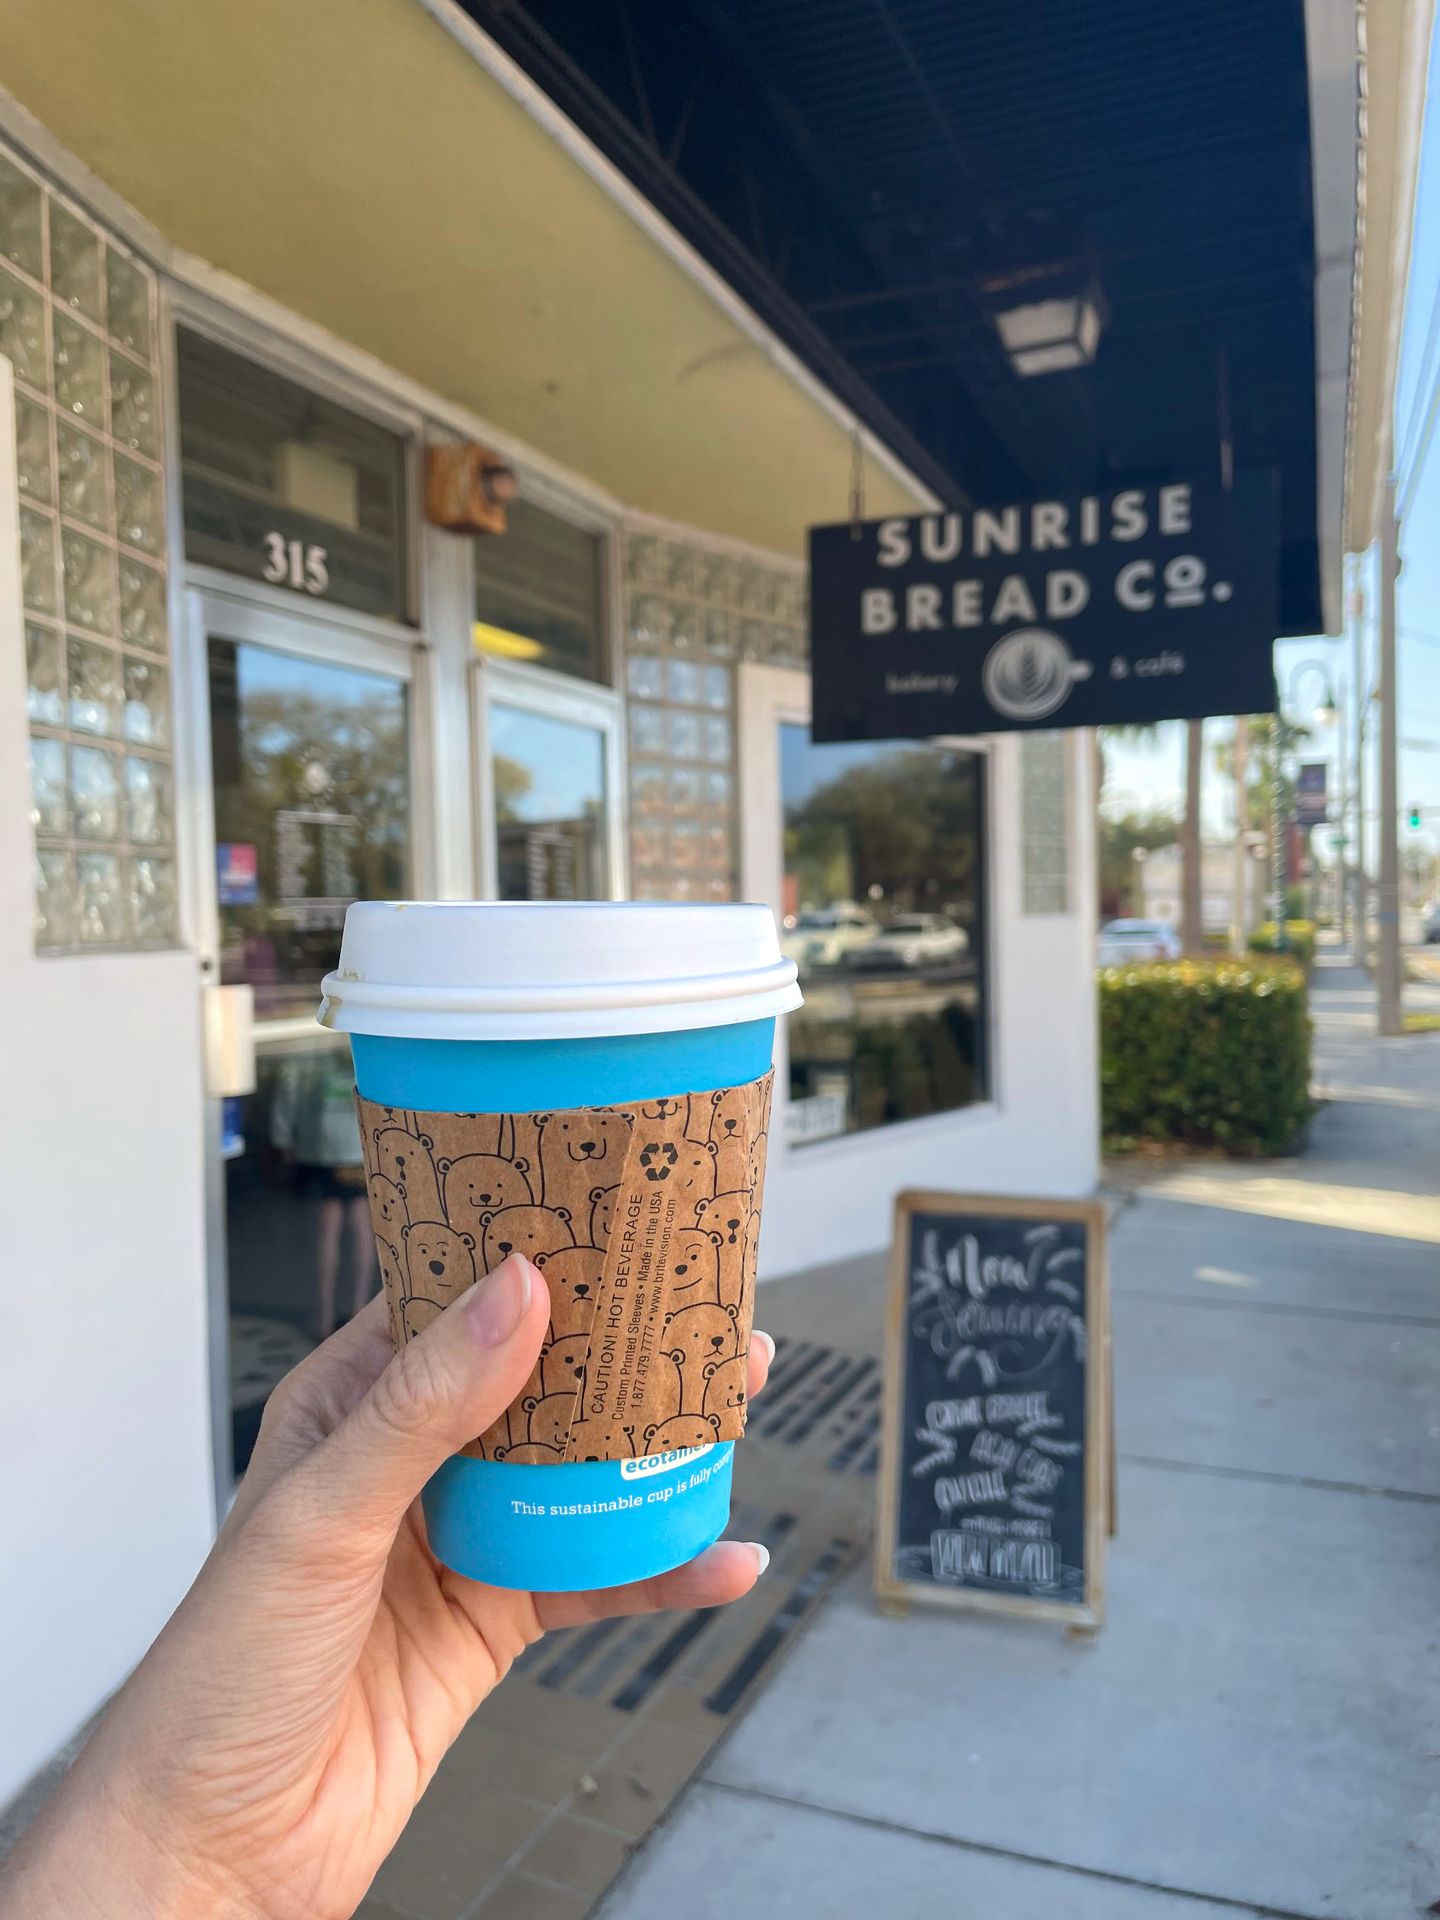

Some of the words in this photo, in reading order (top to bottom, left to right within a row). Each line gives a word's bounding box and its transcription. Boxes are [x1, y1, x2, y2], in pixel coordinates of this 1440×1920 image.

[877, 484, 1193, 567] SUNRISE
[262, 531, 329, 595] 315
[861, 570, 1090, 635] BREAD
[1109, 655, 1128, 680] &
[649, 1190, 664, 1215] USA
[615, 1194, 643, 1288] BEVERAGE
[646, 1238, 655, 1248] in
[647, 1218, 659, 1235] the
[637, 1251, 653, 1281] Made
[606, 1294, 625, 1329] HOT
[628, 1293, 646, 1334] Sleeves
[631, 1325, 656, 1409] 1.877.479.7777
[650, 1199, 676, 1313] www.britevision.com
[591, 1335, 618, 1414] CAUTION!
[620, 1337, 638, 1375] Printed
[612, 1379, 631, 1420] Custom
[511, 1500, 546, 1515] This
[550, 1496, 643, 1516] sustainable
[647, 1487, 673, 1502] cup
[676, 1481, 687, 1493] is
[689, 1468, 712, 1489] fully
